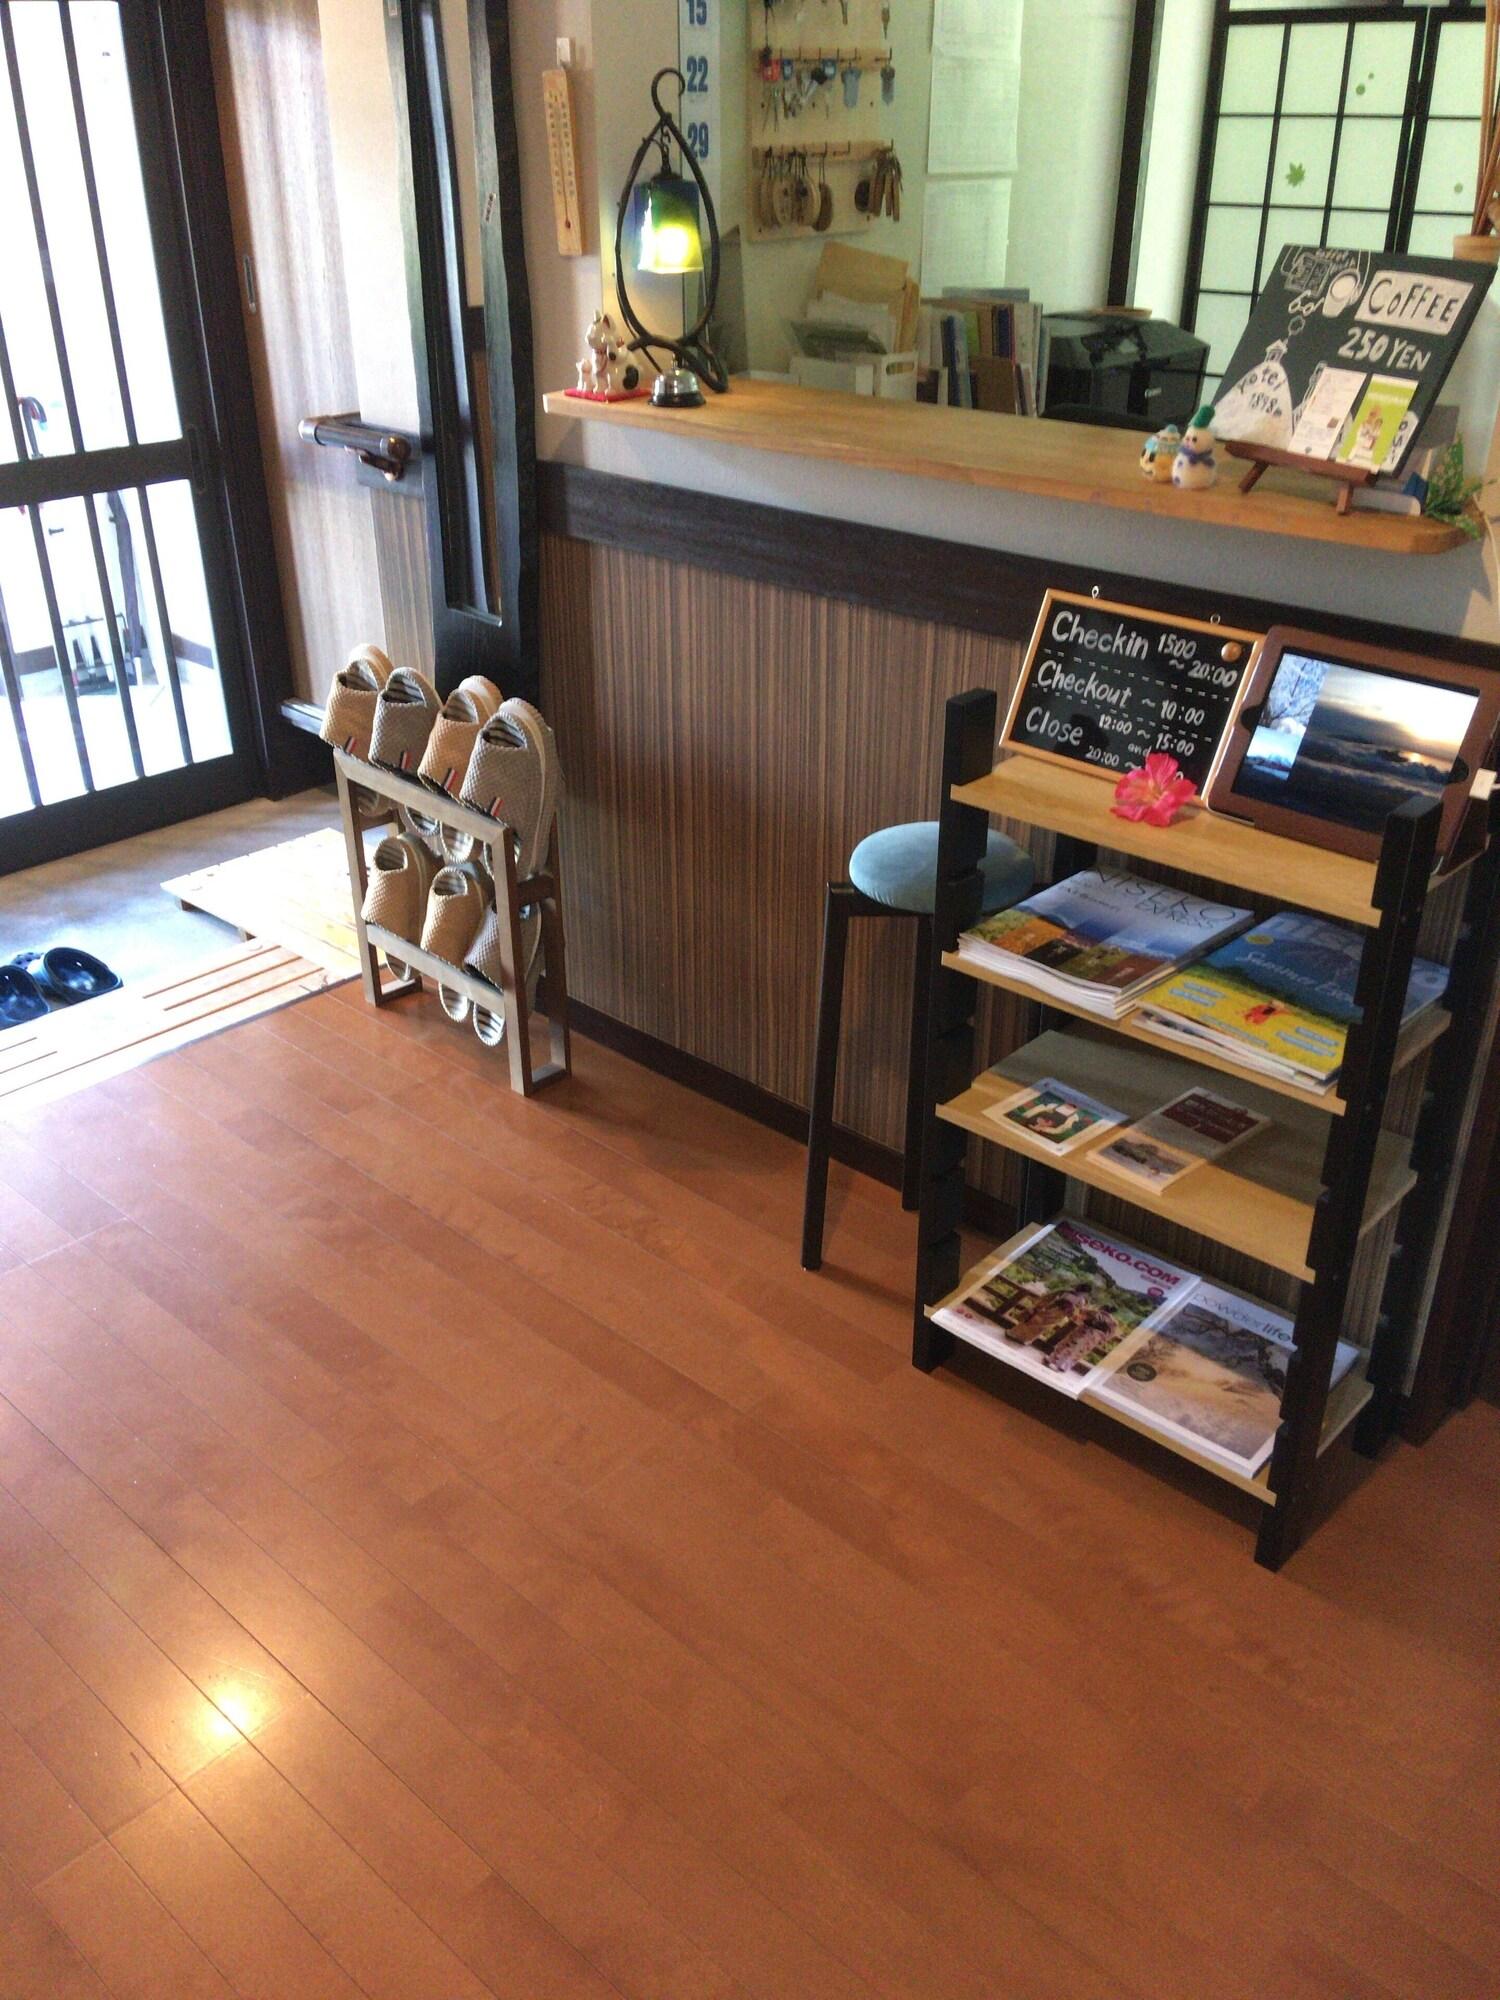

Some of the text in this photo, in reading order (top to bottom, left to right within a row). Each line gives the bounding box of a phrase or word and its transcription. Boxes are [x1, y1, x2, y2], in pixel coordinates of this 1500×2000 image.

[686, 55, 709, 93] 22
[687, 121, 709, 159] 29
[1337, 327, 1432, 373] 250 YEN
[1051, 610, 1149, 660] Checkin
[1037, 660, 1133, 709] Checkout
[1025, 706, 1084, 746] Close
[1099, 713, 1133, 736] 12:00
[1155, 732, 1195, 757] 15:00
[1129, 742, 1152, 758] and
[1085, 745, 1120, 768] 20:00
